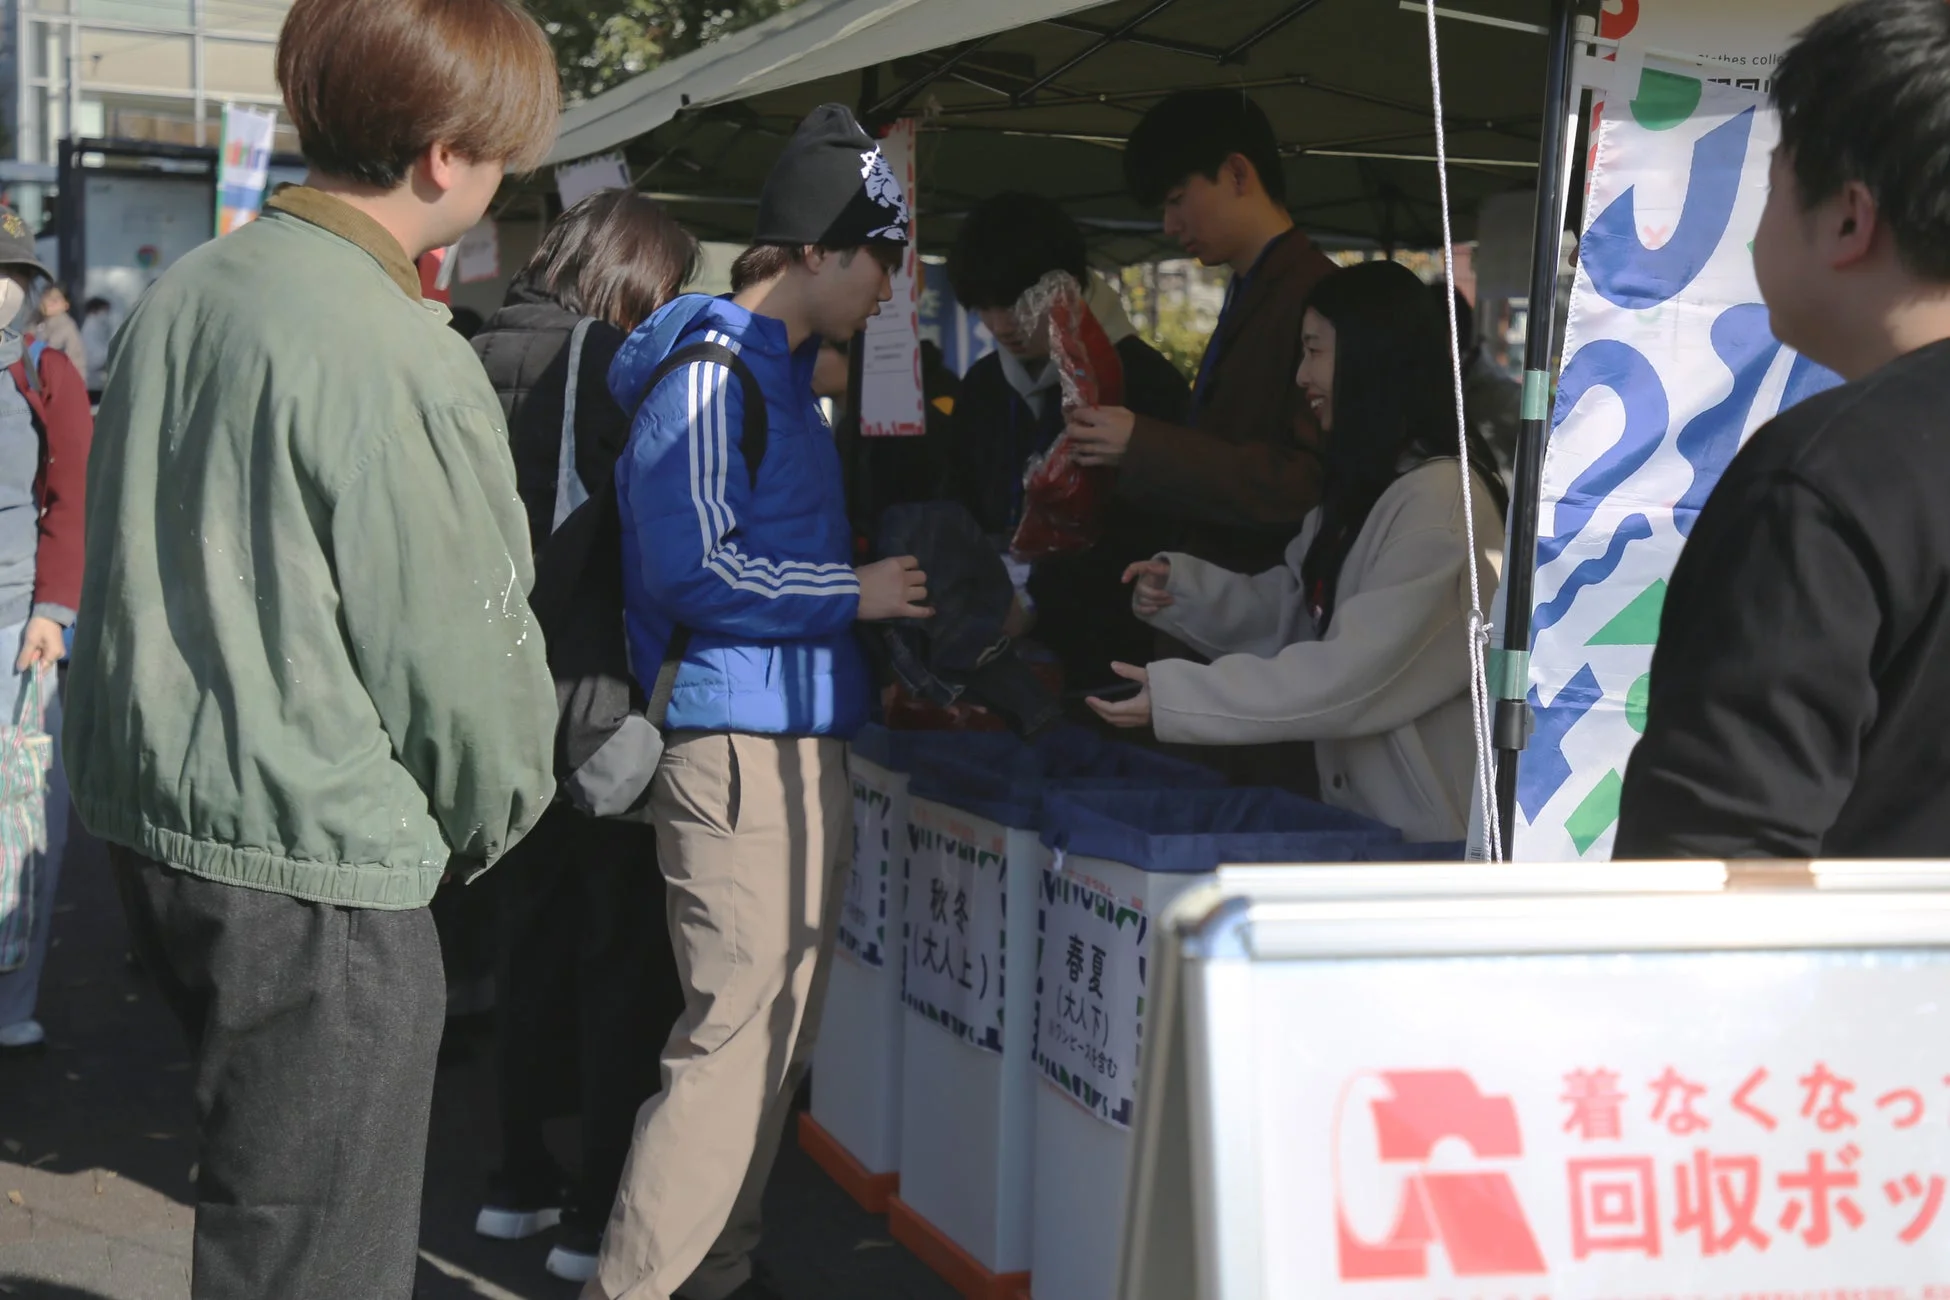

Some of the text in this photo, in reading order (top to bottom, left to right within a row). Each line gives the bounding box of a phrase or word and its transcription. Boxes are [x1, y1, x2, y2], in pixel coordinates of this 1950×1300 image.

[1696, 54, 1746, 66] thes
[930, 877, 968, 935] 秋冬
[1066, 932, 1107, 1000] 春夏
[1558, 1062, 1950, 1141] 着なくなっ
[1565, 1143, 1947, 1260] 回収ボッ
